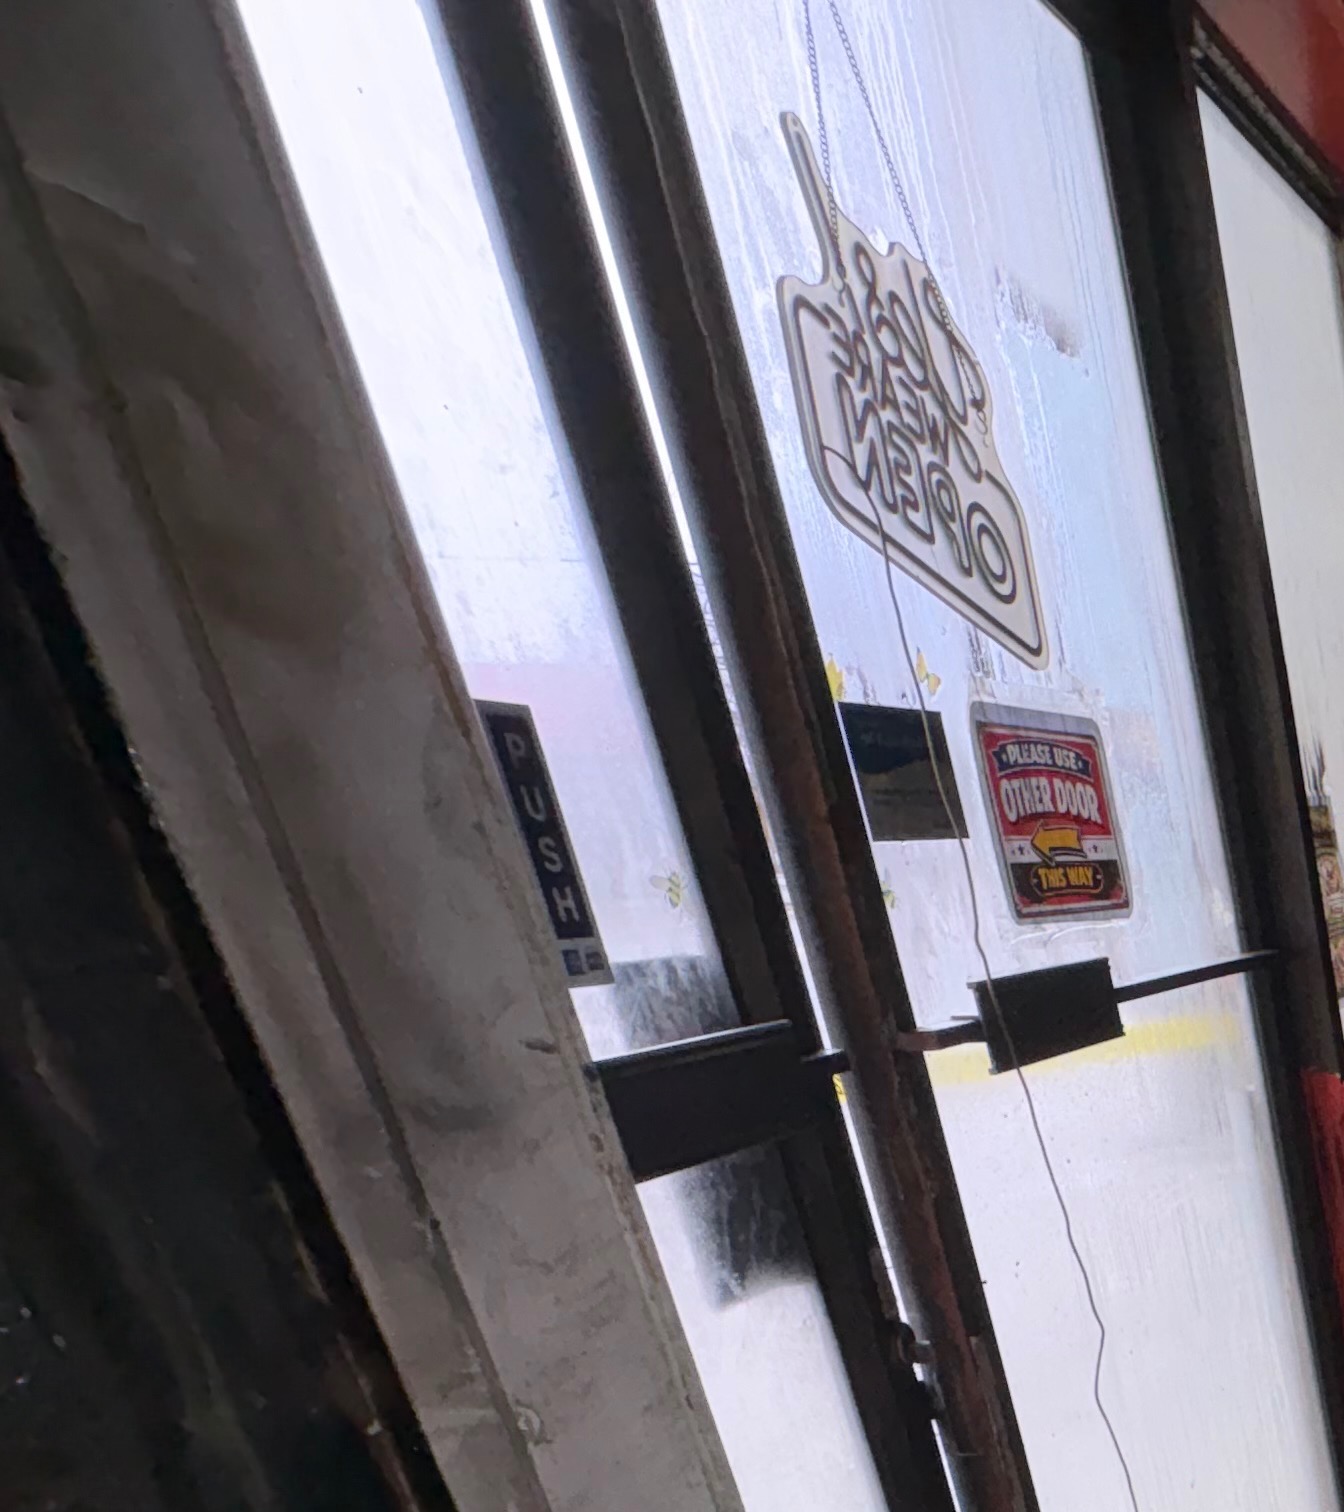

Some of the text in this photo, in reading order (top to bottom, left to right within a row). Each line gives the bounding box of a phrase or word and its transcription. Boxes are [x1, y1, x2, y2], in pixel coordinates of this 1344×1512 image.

[1005, 740, 1079, 770] PLEASE USE
[1000, 775, 1103, 824] OTHER DOOR
[503, 731, 581, 923] PUSH
[1037, 866, 1094, 890] THIS WAY
